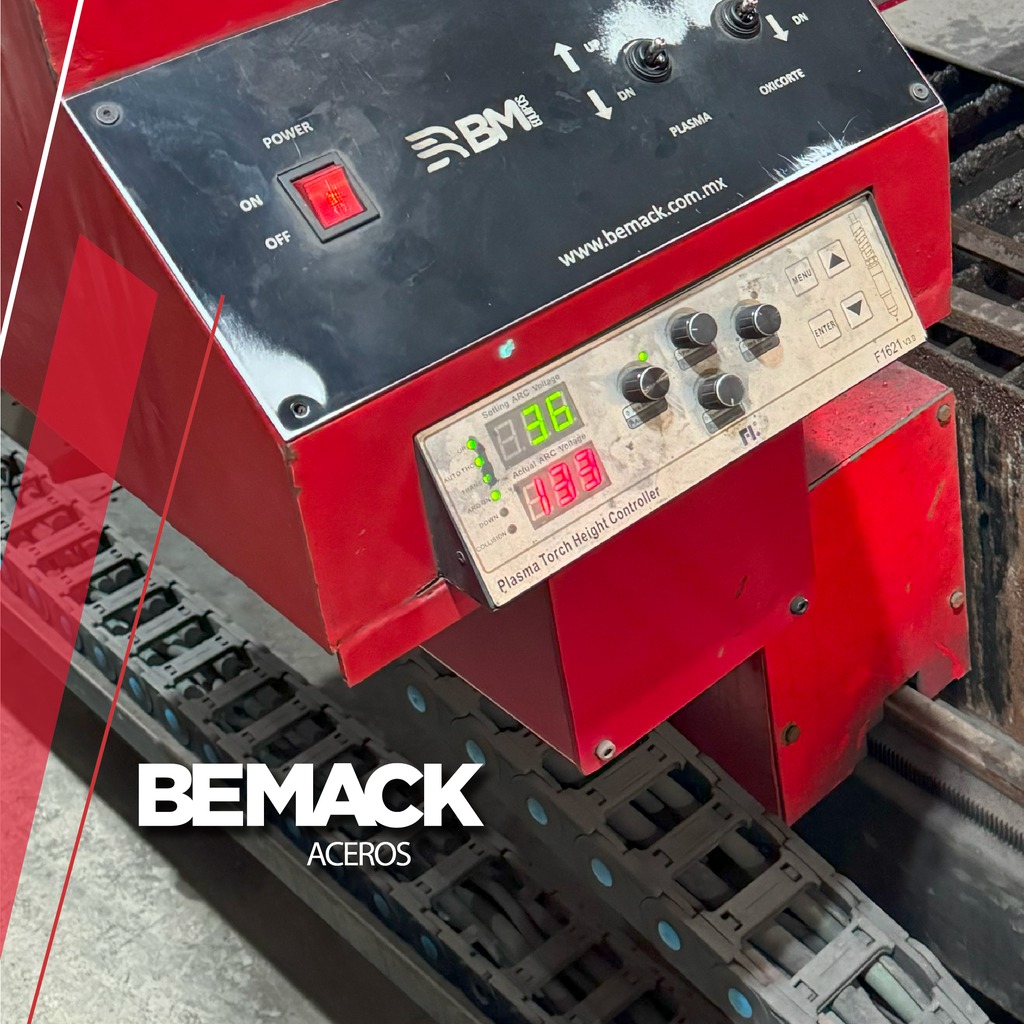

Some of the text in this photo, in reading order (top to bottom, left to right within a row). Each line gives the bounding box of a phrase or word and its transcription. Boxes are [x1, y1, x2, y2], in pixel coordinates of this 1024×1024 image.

[792, 12, 808, 26] DN
[617, 87, 636, 102] DN
[758, 68, 806, 96] OXICORTE
[262, 121, 314, 150] POWER
[455, 99, 532, 154] BM
[669, 112, 712, 138] PLASMA
[239, 194, 263, 213] ON
[557, 177, 728, 267] www.bemack.com.mx
[264, 230, 292, 250] OFF
[791, 269, 812, 285] MENU
[813, 320, 836, 338] ENTER
[873, 338, 903, 363] F1621
[481, 374, 561, 419] Setting ARC Voltage
[522, 390, 574, 446] 36
[512, 433, 587, 479] Actual ARC Voltage
[534, 447, 603, 516] 133
[479, 514, 499, 529] DOWN
[475, 530, 507, 553] COLLISION
[497, 485, 661, 594] Plasma Torch Height Controller
